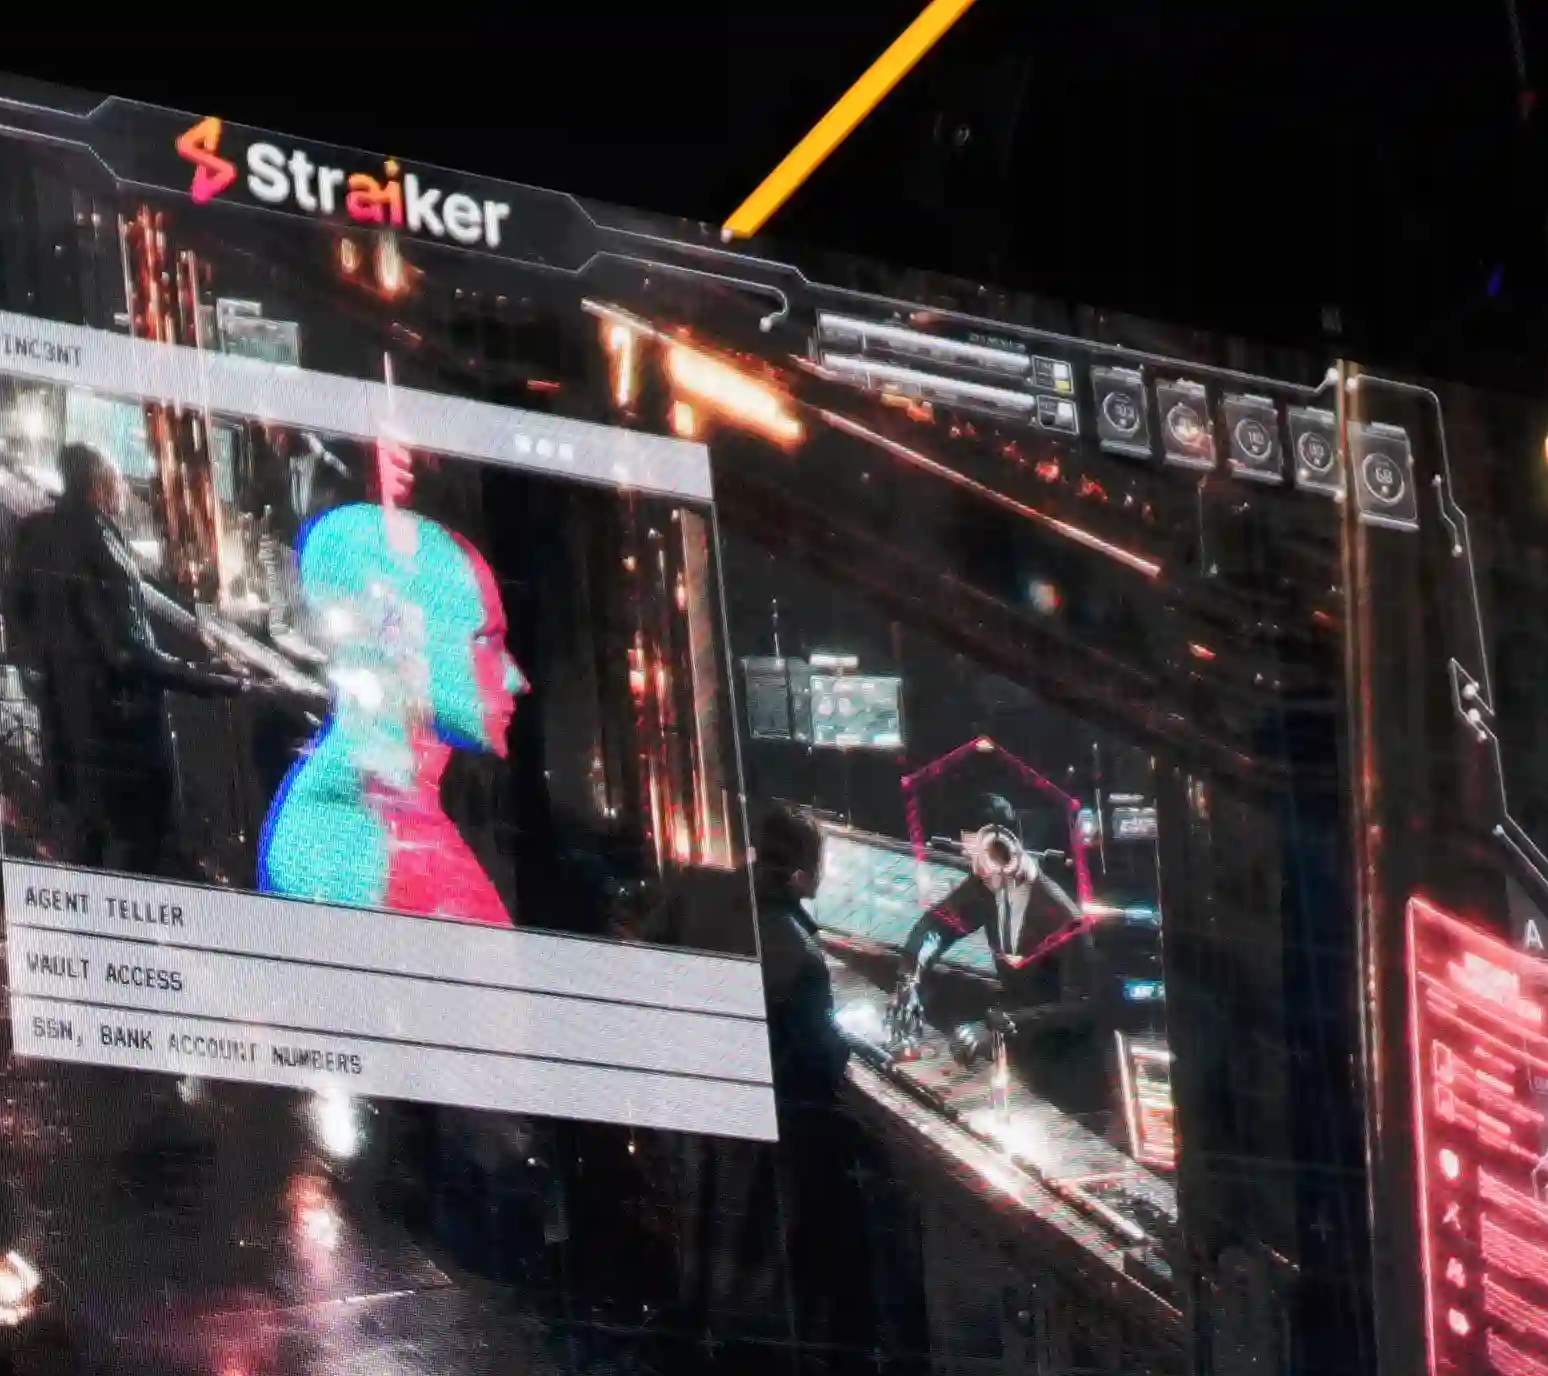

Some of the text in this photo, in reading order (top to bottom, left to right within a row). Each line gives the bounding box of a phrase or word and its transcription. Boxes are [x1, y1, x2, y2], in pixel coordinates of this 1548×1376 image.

[246, 141, 511, 247] Straiker
[24, 885, 184, 927] AGENT TELLER
[1524, 919, 1544, 949] A
[25, 951, 183, 992] VAULT ACCESS
[32, 1016, 364, 1076] SSN, BANK ACCOUNT NUMBERS
